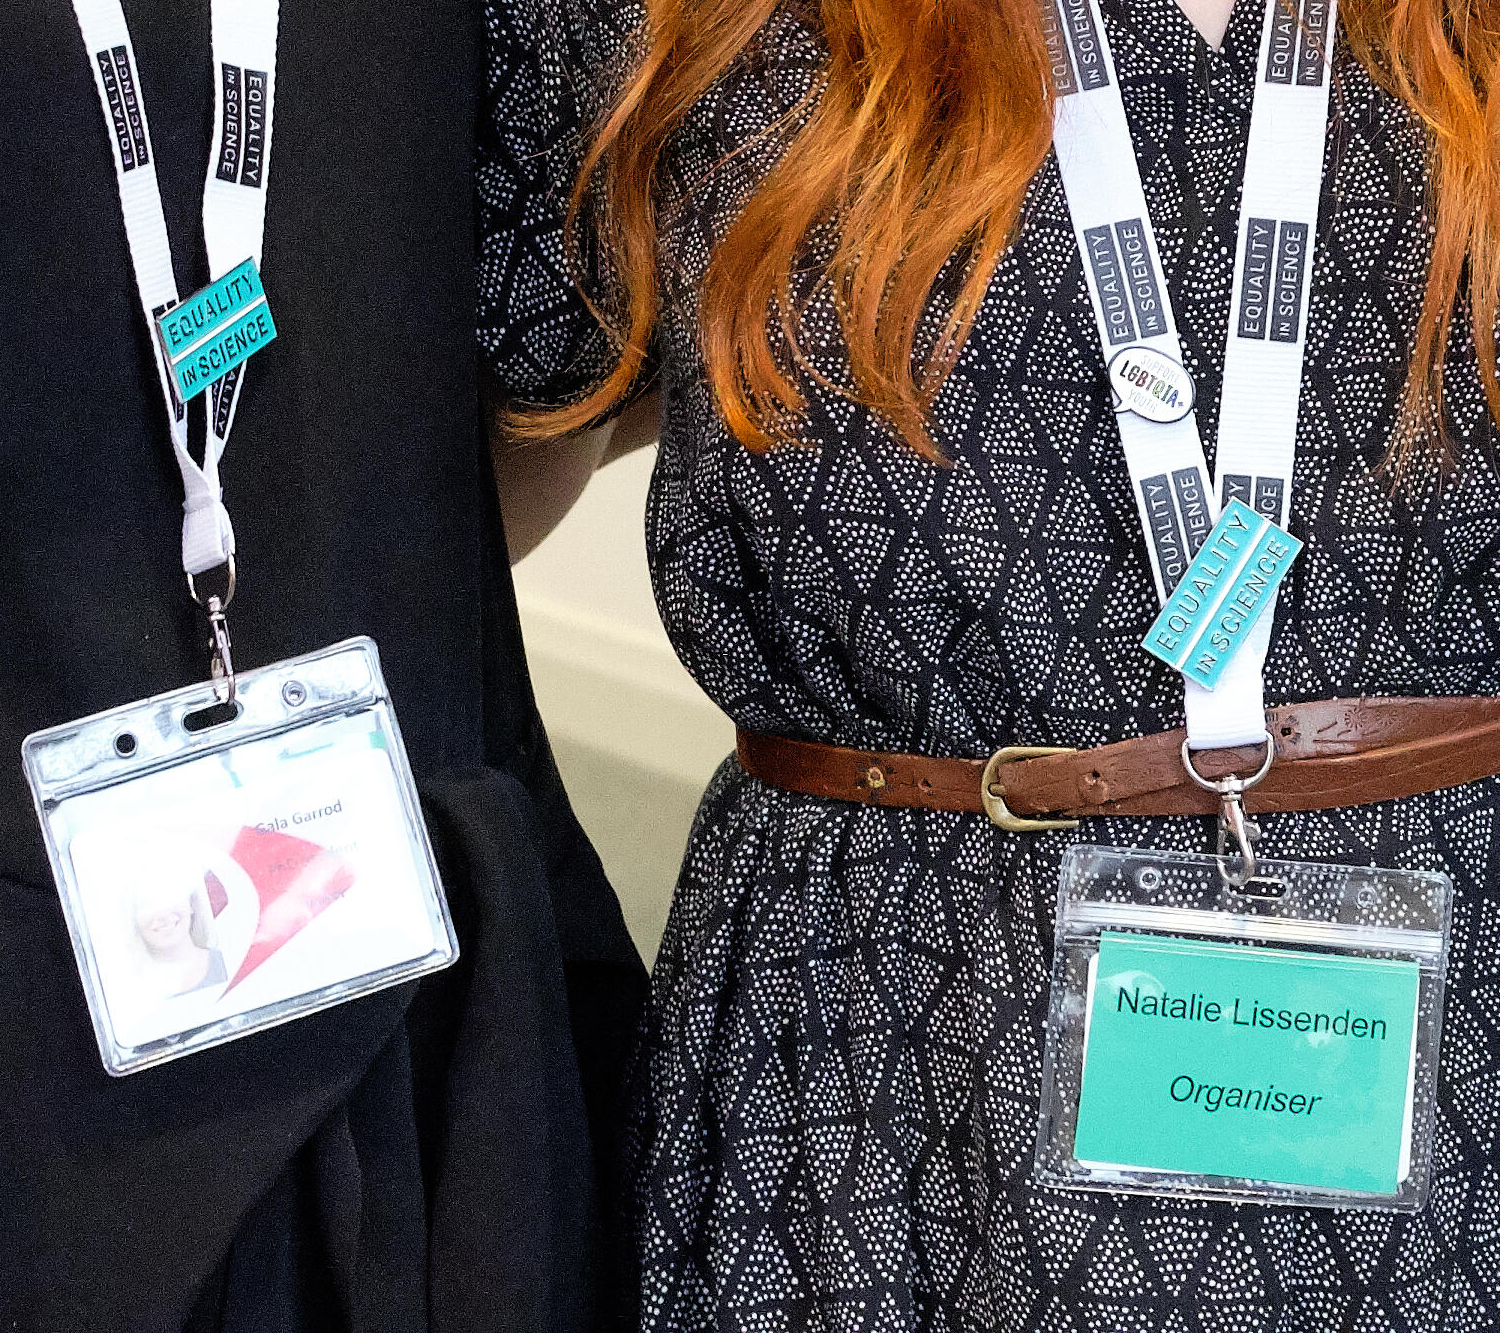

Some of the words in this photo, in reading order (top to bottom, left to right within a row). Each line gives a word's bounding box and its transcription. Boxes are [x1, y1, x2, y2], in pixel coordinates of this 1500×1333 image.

[100, 59, 132, 165] EQUALITY
[227, 70, 235, 84] IN
[1087, 69, 1101, 84] IN
[1306, 66, 1317, 80] IN
[222, 89, 238, 175] SCIENCE
[246, 76, 262, 181] EQUALITY
[168, 270, 253, 346] EQUALITY
[1091, 234, 1129, 338] EQUALITY
[1123, 226, 1156, 311] SCIENCE
[1244, 225, 1269, 333] EQUALITY
[1280, 229, 1301, 317] SCIENCE
[182, 365, 196, 388] IN
[199, 314, 268, 377] SCIENCE
[1147, 315, 1159, 330] IN
[1279, 322, 1290, 336] IN
[1148, 484, 1182, 589] QUALITY
[1156, 511, 1249, 651] EQUALITY
[1195, 653, 1216, 675] IN
[1211, 537, 1290, 653] SCIENCE
[292, 799, 342, 825] Garrod
[1117, 986, 1222, 1022] Natalie
[1232, 997, 1388, 1040] Lissenden
[1170, 1075, 1323, 1116] Organiser
